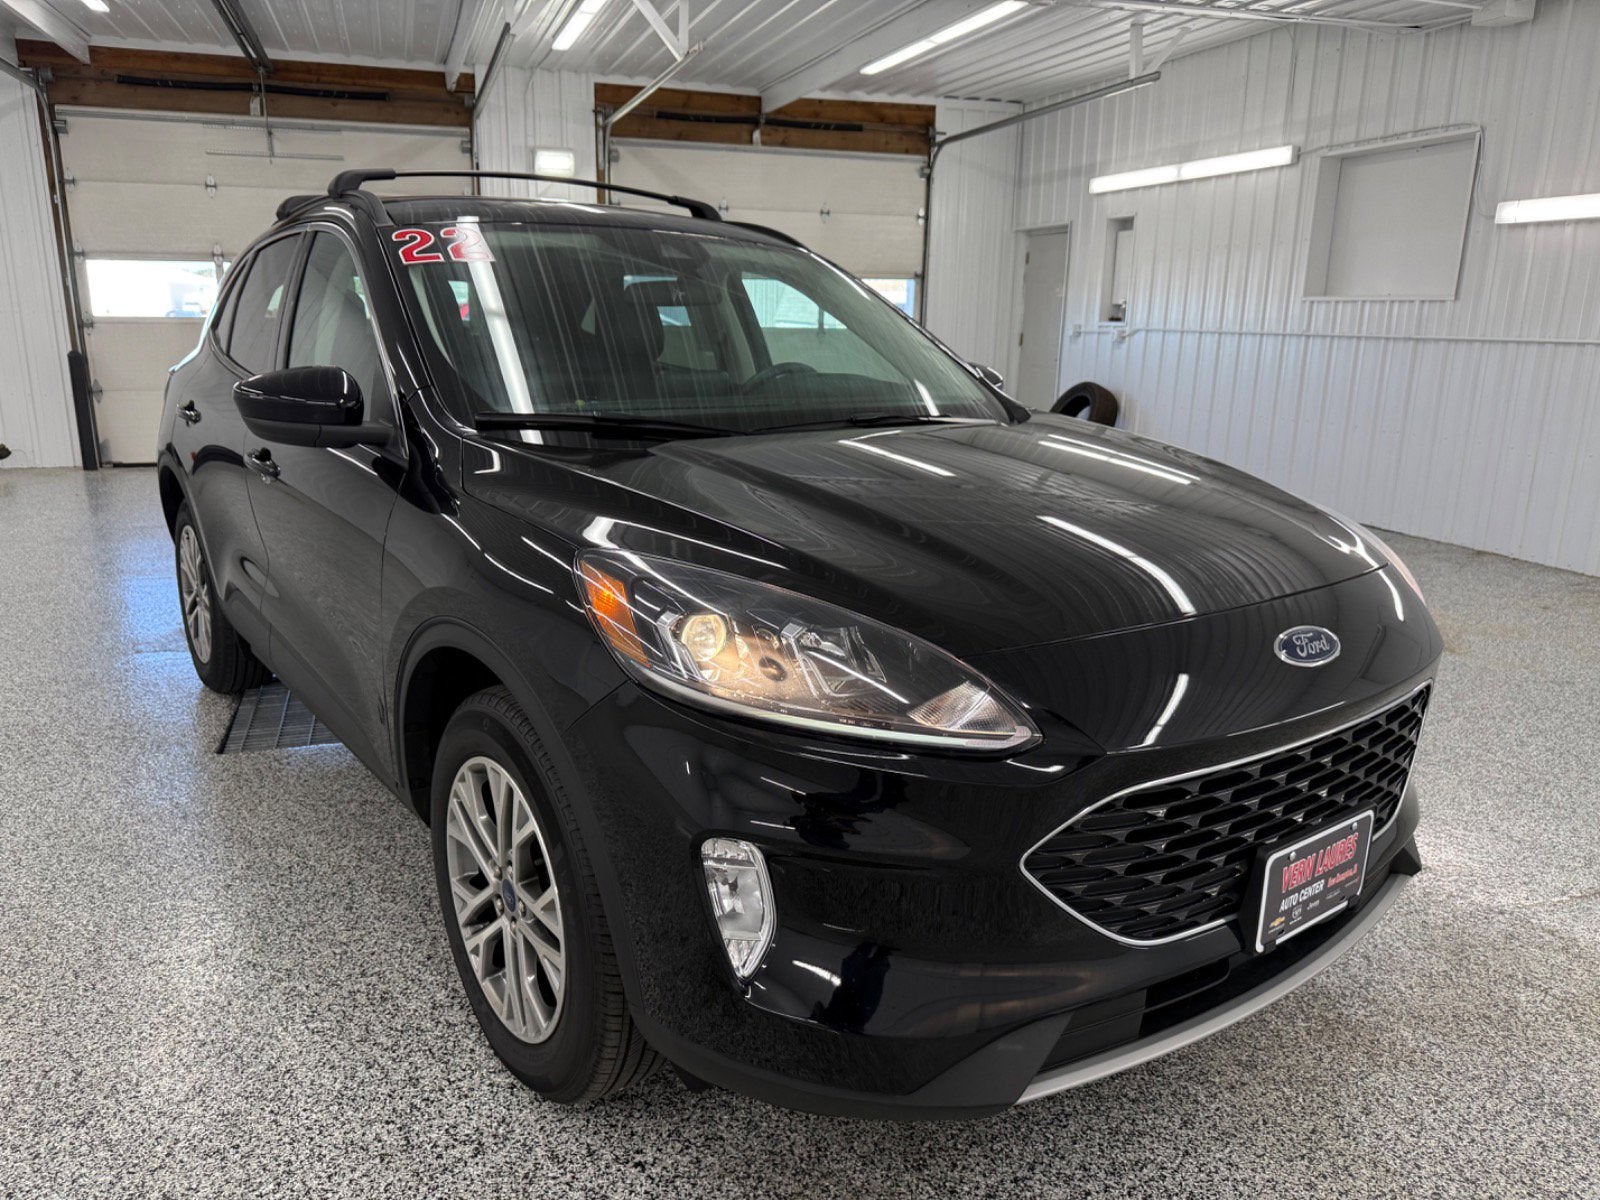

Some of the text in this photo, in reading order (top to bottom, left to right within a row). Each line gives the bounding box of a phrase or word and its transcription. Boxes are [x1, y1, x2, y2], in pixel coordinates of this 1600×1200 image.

[392, 228, 496, 264] 22
[1292, 632, 1330, 658] Ford
[1282, 853, 1316, 893] VERN
[1315, 832, 1359, 876] LAURES
[1279, 893, 1299, 912] AUTO
[1299, 879, 1325, 901] CENTER
